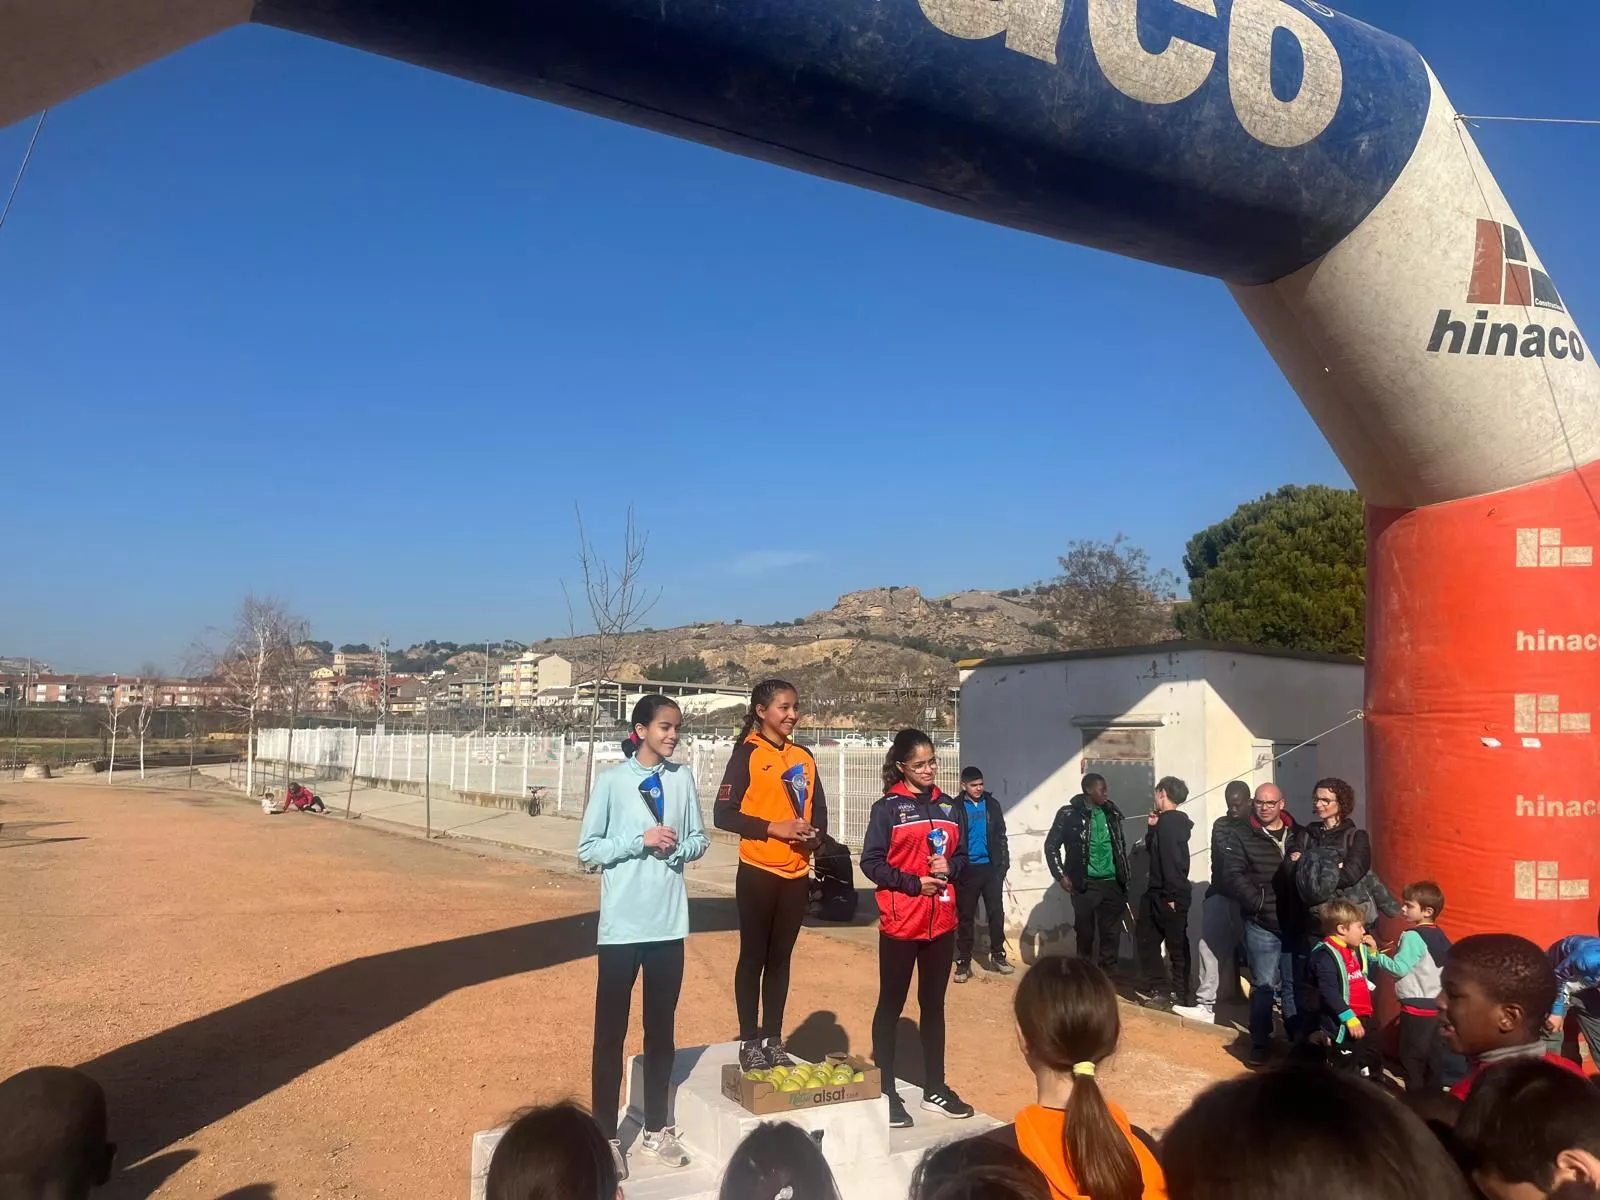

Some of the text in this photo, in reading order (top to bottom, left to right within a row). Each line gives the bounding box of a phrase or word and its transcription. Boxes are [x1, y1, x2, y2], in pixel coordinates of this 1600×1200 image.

[1426, 309, 1585, 362] hinaco
[1516, 628, 1600, 652] hinac
[1516, 794, 1600, 817] hinac
[813, 1086, 846, 1104] alsat
